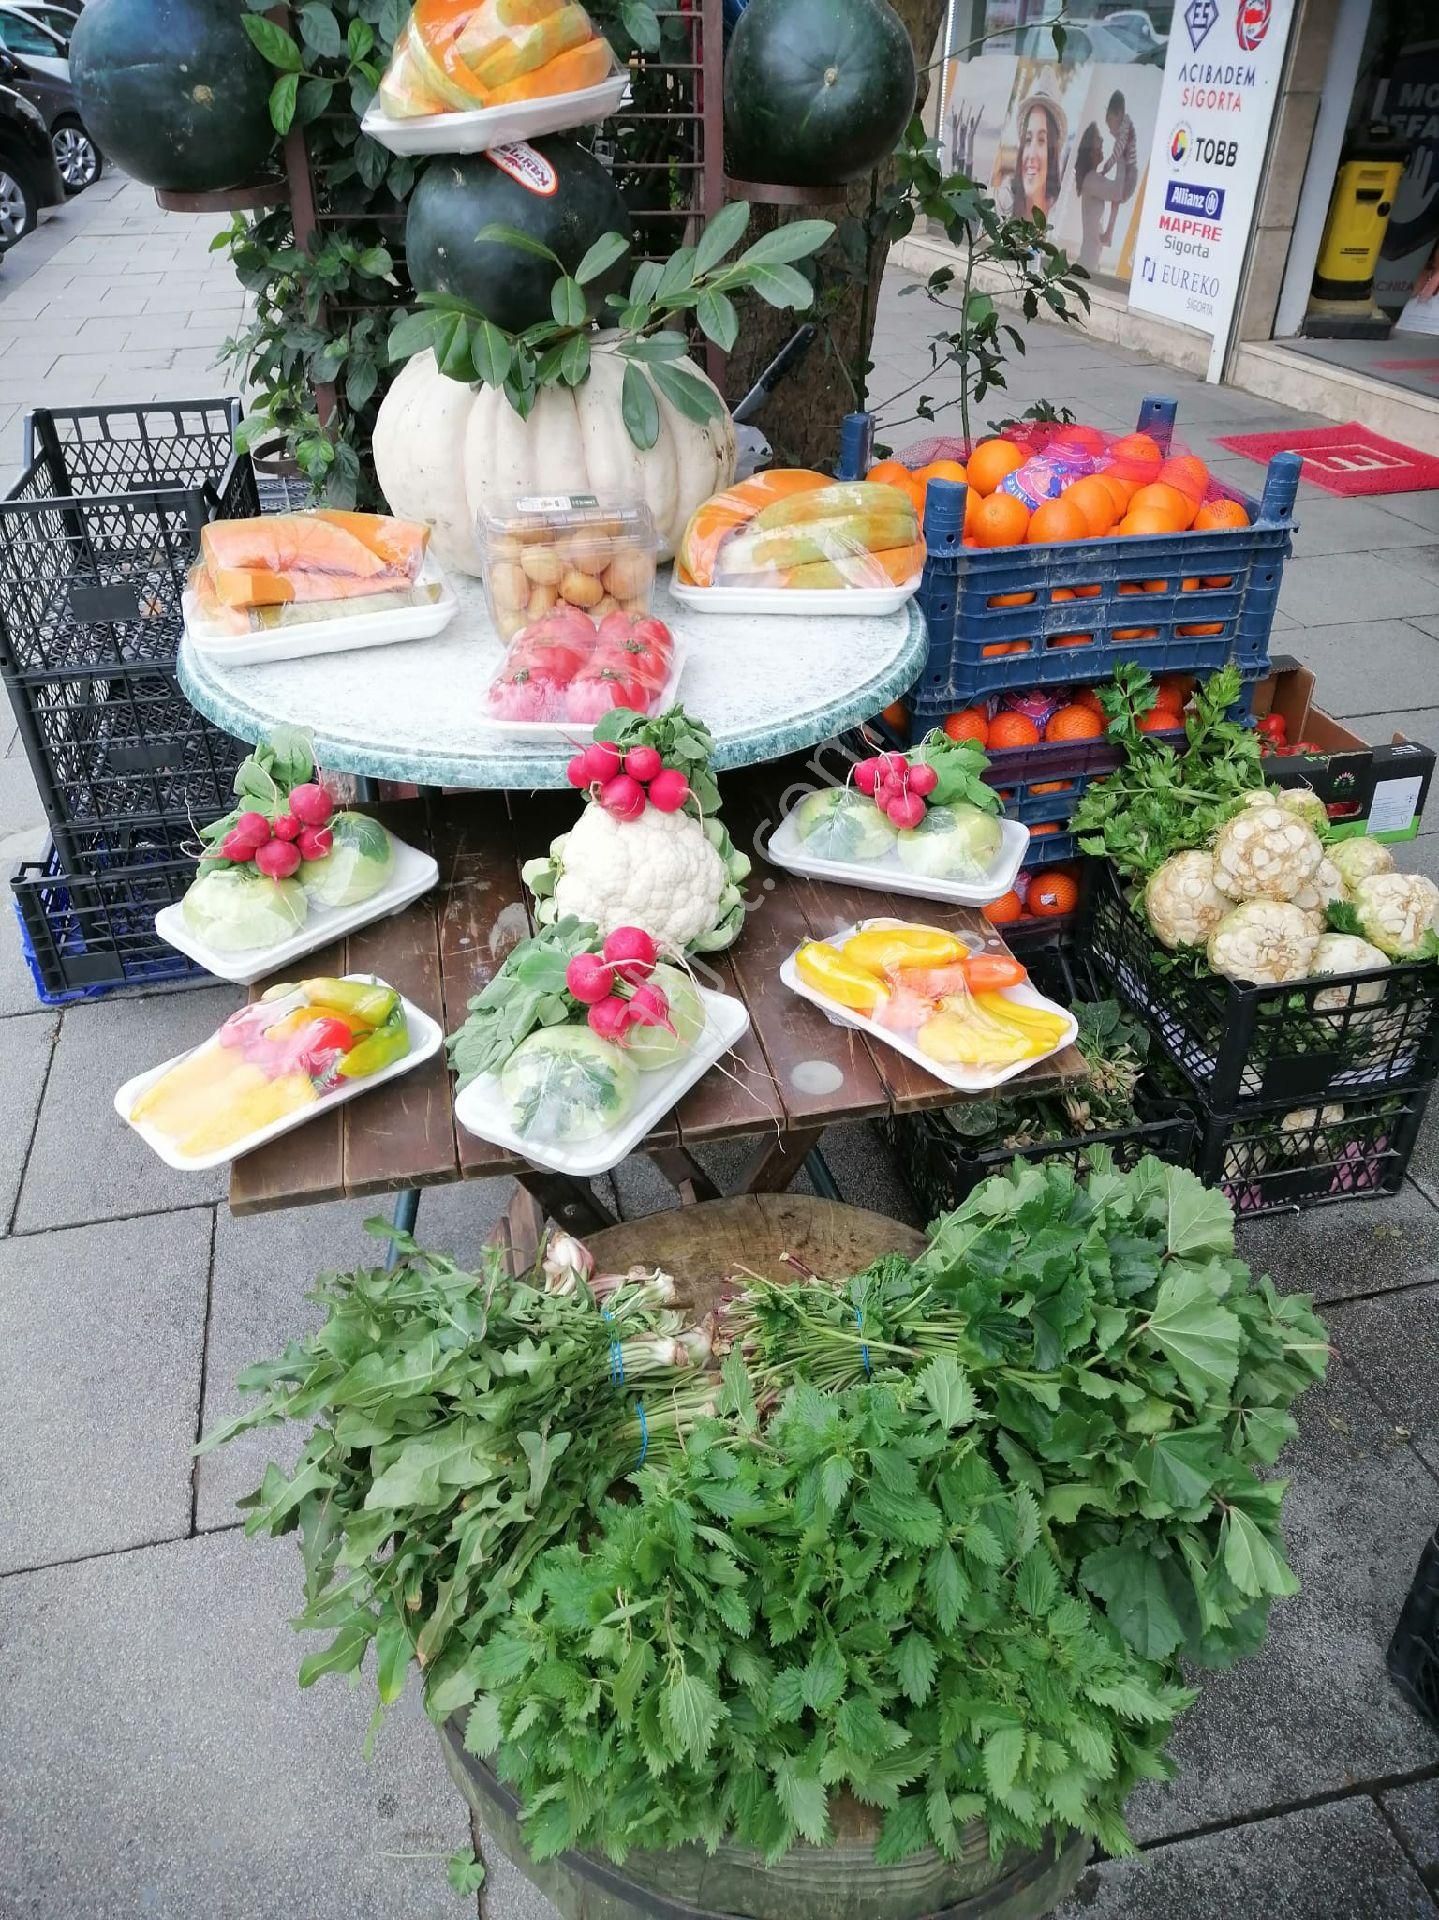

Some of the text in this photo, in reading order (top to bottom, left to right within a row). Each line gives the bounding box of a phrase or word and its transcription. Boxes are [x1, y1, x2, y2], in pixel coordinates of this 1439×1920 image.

[1178, 63, 1256, 87] ACIBADEM
[1195, 137, 1240, 168] TOBB
[1171, 186, 1206, 209] Allianz
[1158, 215, 1223, 242] MAPFRE
[1164, 234, 1210, 259] Sigorta
[1161, 264, 1220, 298] EUREKO
